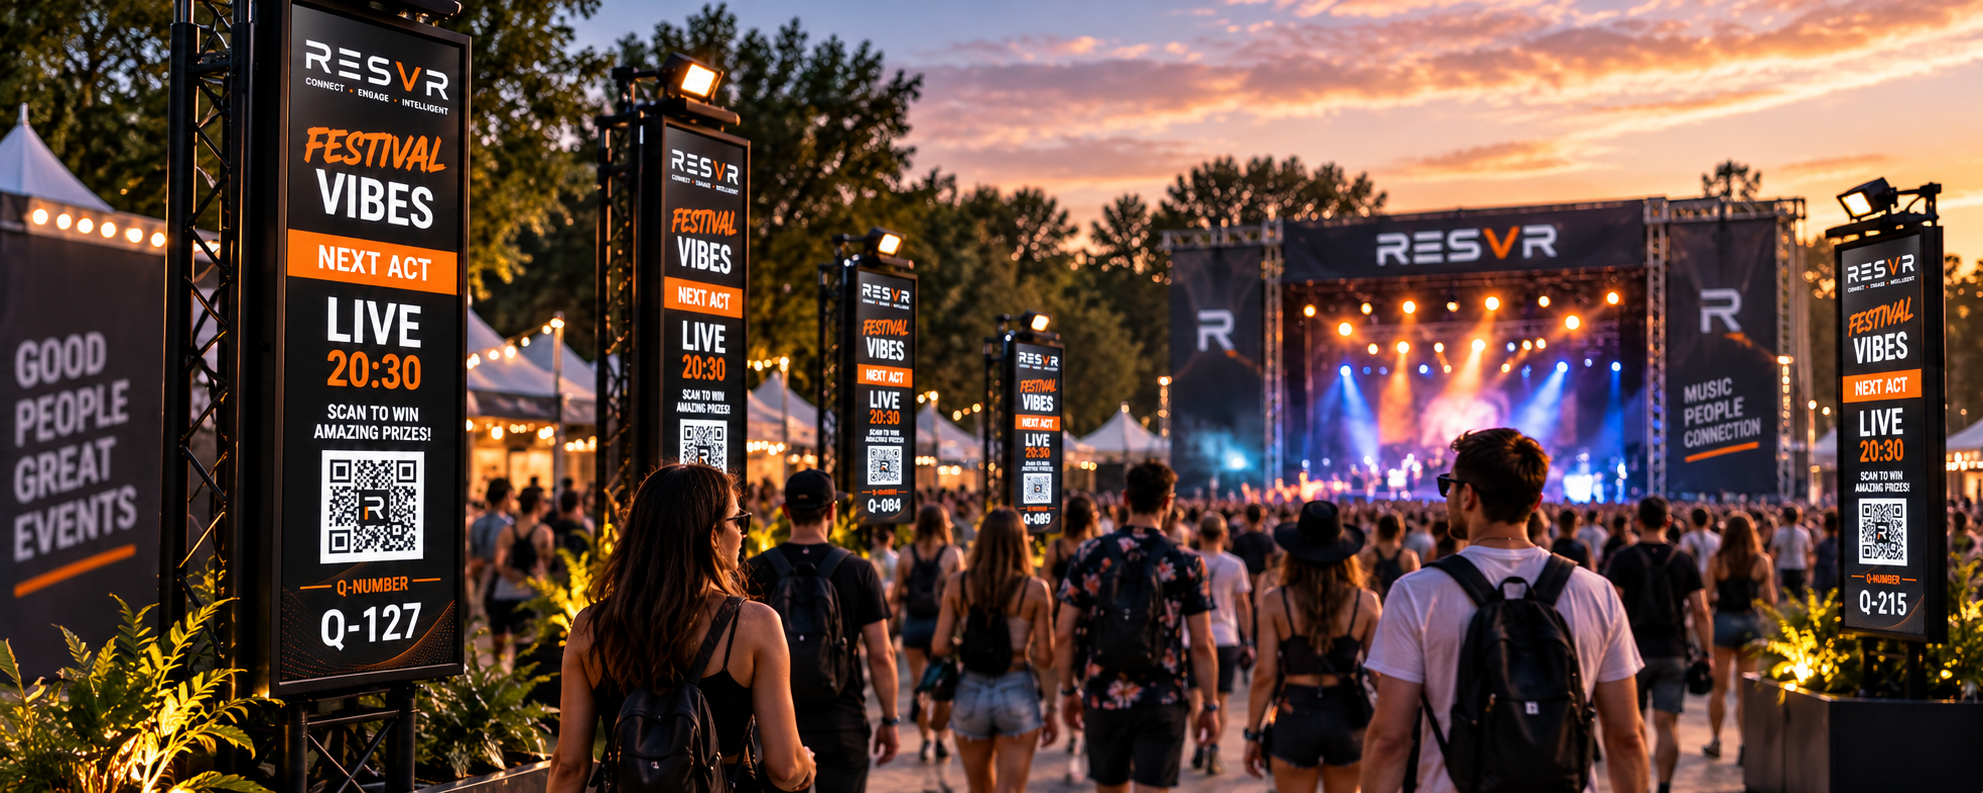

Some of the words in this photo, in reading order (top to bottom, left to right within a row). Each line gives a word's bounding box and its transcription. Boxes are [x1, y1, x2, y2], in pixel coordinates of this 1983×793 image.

[306, 39, 449, 100] RESVR
[306, 77, 345, 92] CONNECT
[402, 98, 448, 115] INTELLIGENT
[304, 126, 446, 172] FESTIVAL
[672, 149, 738, 185] RESVR
[316, 168, 434, 230] VIBES
[672, 208, 738, 236] FESTIVAL
[677, 236, 732, 274] VIBES
[1377, 225, 1556, 265] RESVR
[319, 245, 380, 275] NEXT
[387, 255, 431, 281] ACT
[1848, 254, 1914, 284] RESVR
[678, 286, 707, 308] NEXT
[710, 292, 730, 310] ACT
[862, 283, 910, 304] RESVR
[328, 296, 422, 348] LIVE
[862, 318, 908, 336] FESTIVAL
[1848, 296, 1914, 338] FESTIVAL
[682, 320, 726, 354] LIVE
[866, 336, 904, 361] VIBES
[1854, 331, 1908, 364] VIBES
[15, 331, 106, 390] GOOD
[326, 348, 422, 391] 20:30
[682, 354, 726, 381] 20:30
[1019, 352, 1058, 366] RESVR
[866, 368, 886, 382] NEXT
[888, 372, 904, 384] ACT
[1856, 379, 1883, 396] NEXT
[1886, 377, 1907, 393] ACT
[702, 390, 710, 400] TO
[870, 390, 900, 409] LIVE
[1022, 393, 1054, 412] VIBES
[1684, 377, 1732, 404] MUSIC
[15, 378, 130, 448] PEOPLE
[328, 404, 366, 420] SCAN
[371, 406, 388, 421] TO
[393, 407, 418, 422] WIN
[870, 409, 900, 425] 20:30
[1684, 396, 1744, 428] PEOPLE
[1860, 408, 1903, 436] LIVE
[314, 424, 378, 439] AMAZING
[383, 426, 430, 441] PRIZES!
[1026, 433, 1050, 446] LIVE
[1684, 417, 1761, 448] CONNECTION
[1025, 446, 1050, 458] 20:30
[1860, 438, 1903, 462] 20:30
[14, 436, 117, 504] GREAT
[1861, 471, 1878, 481] SCAN
[1879, 471, 1888, 480] TO
[868, 498, 901, 513] Q-084
[1024, 513, 1050, 525] Q-089
[14, 484, 137, 563] EVENTS
[337, 576, 408, 597] Q-NUMBER
[1860, 590, 1906, 615] Q-215
[321, 602, 422, 651] Q-127
